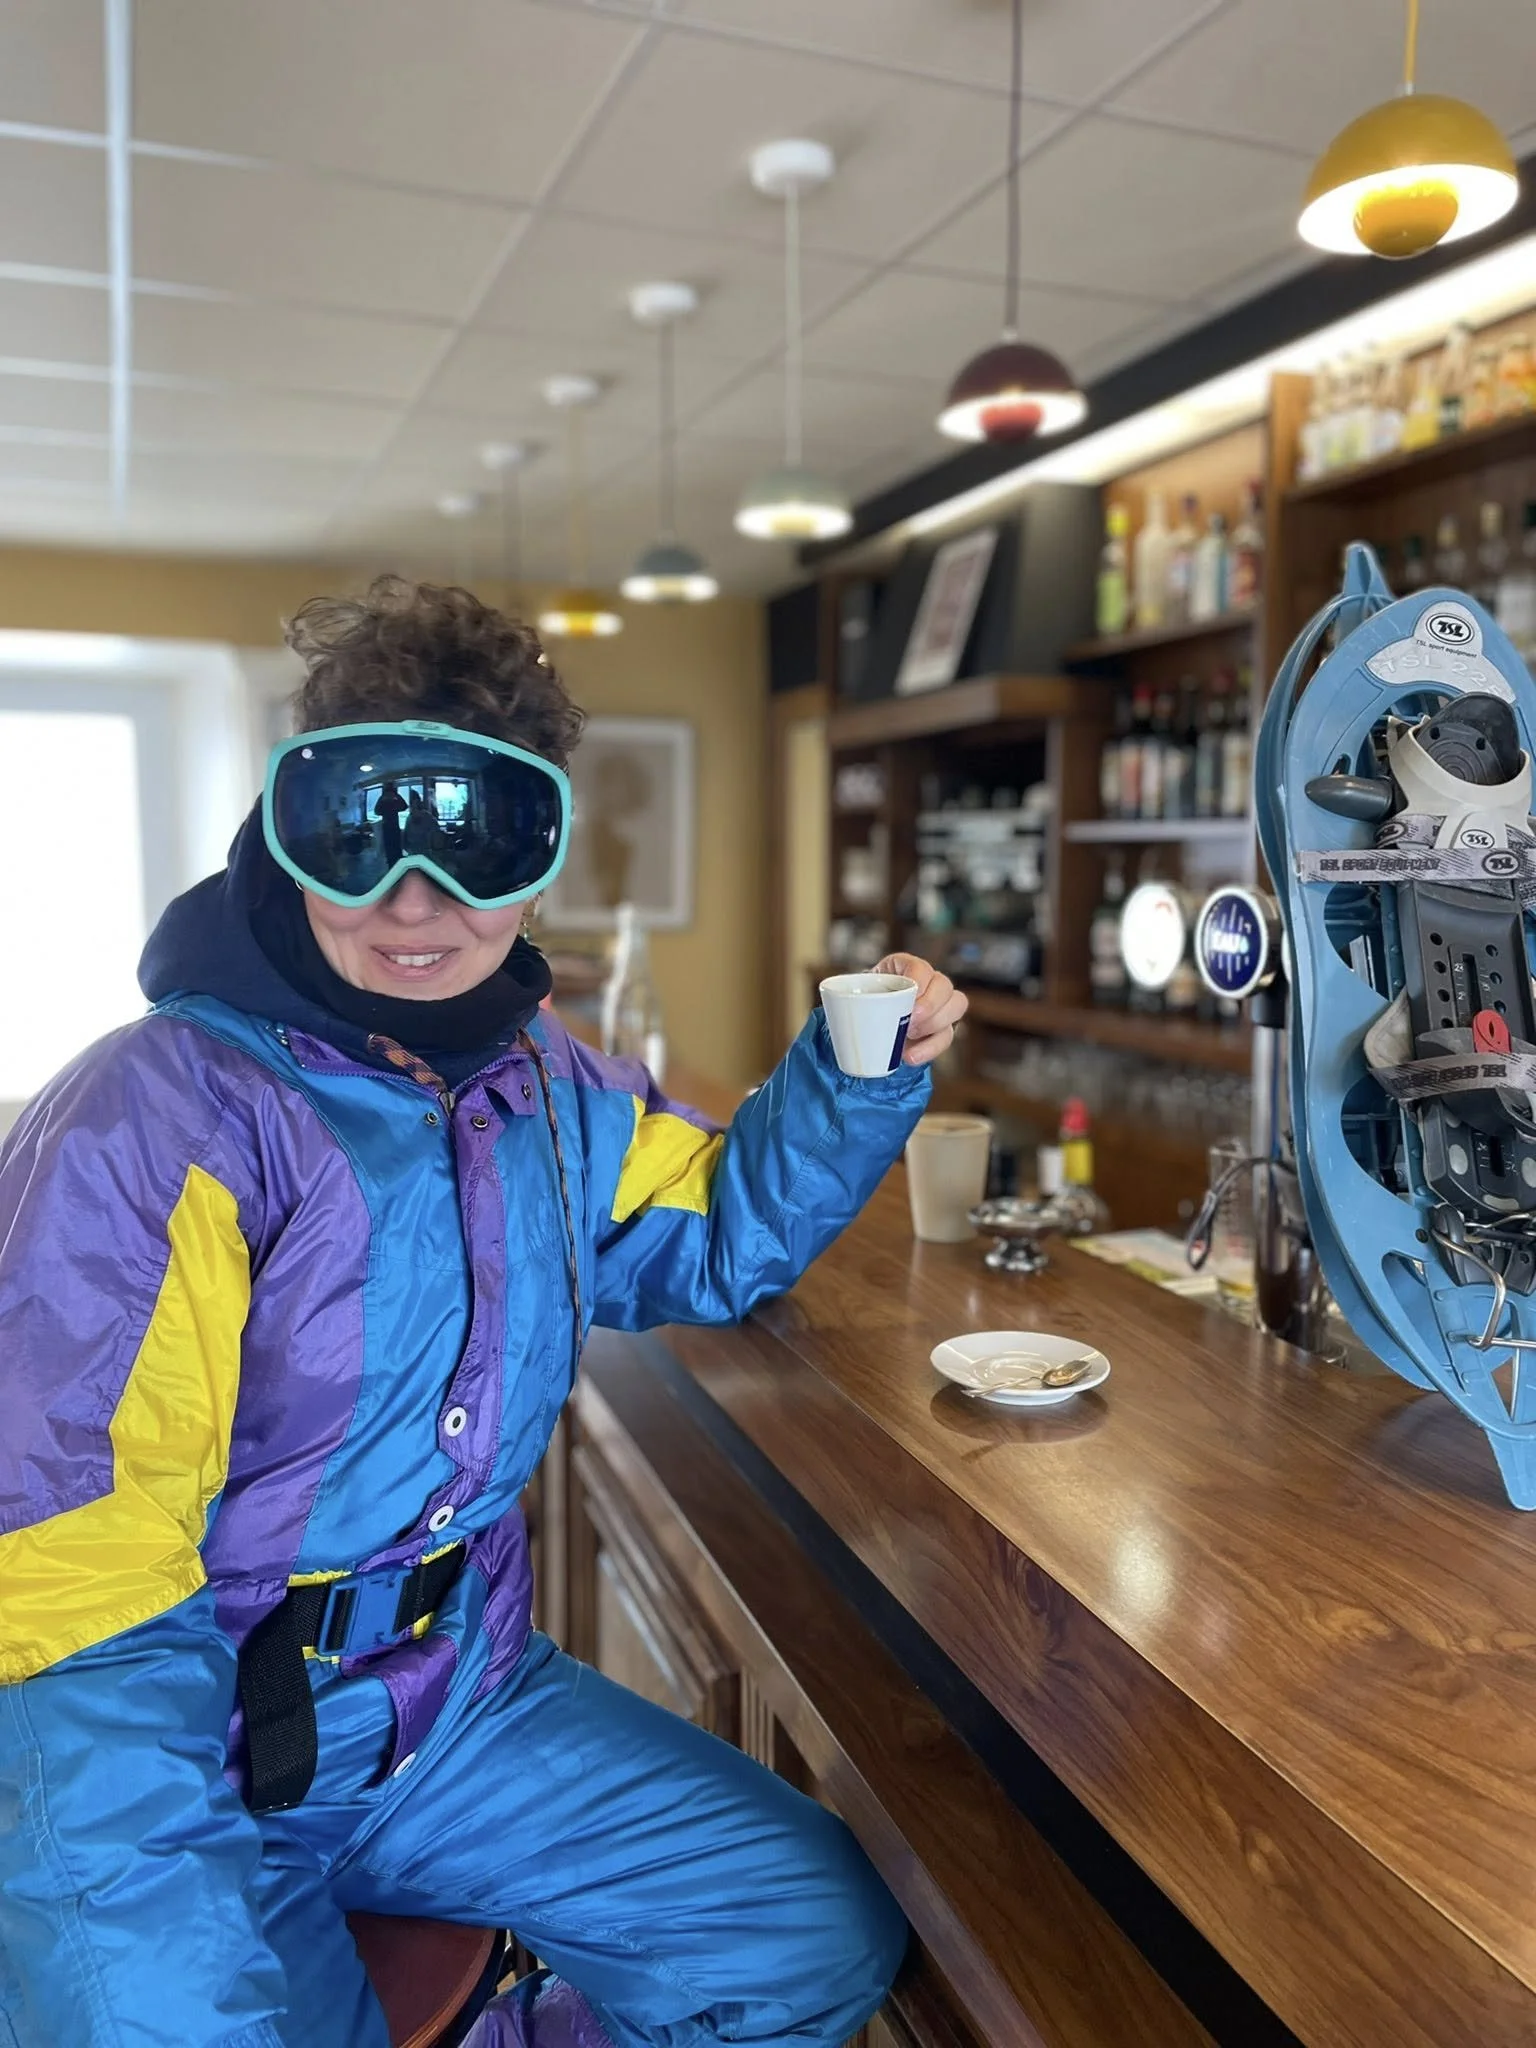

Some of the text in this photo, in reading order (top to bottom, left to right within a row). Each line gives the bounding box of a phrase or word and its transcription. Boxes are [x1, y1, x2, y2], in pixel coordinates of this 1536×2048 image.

[1437, 620, 1464, 638] TSL
[1415, 639, 1478, 659] TSL sport equipment
[1381, 652, 1441, 674] TSL
[1467, 833, 1488, 846] TSL
[1489, 857, 1514, 870] TSL
